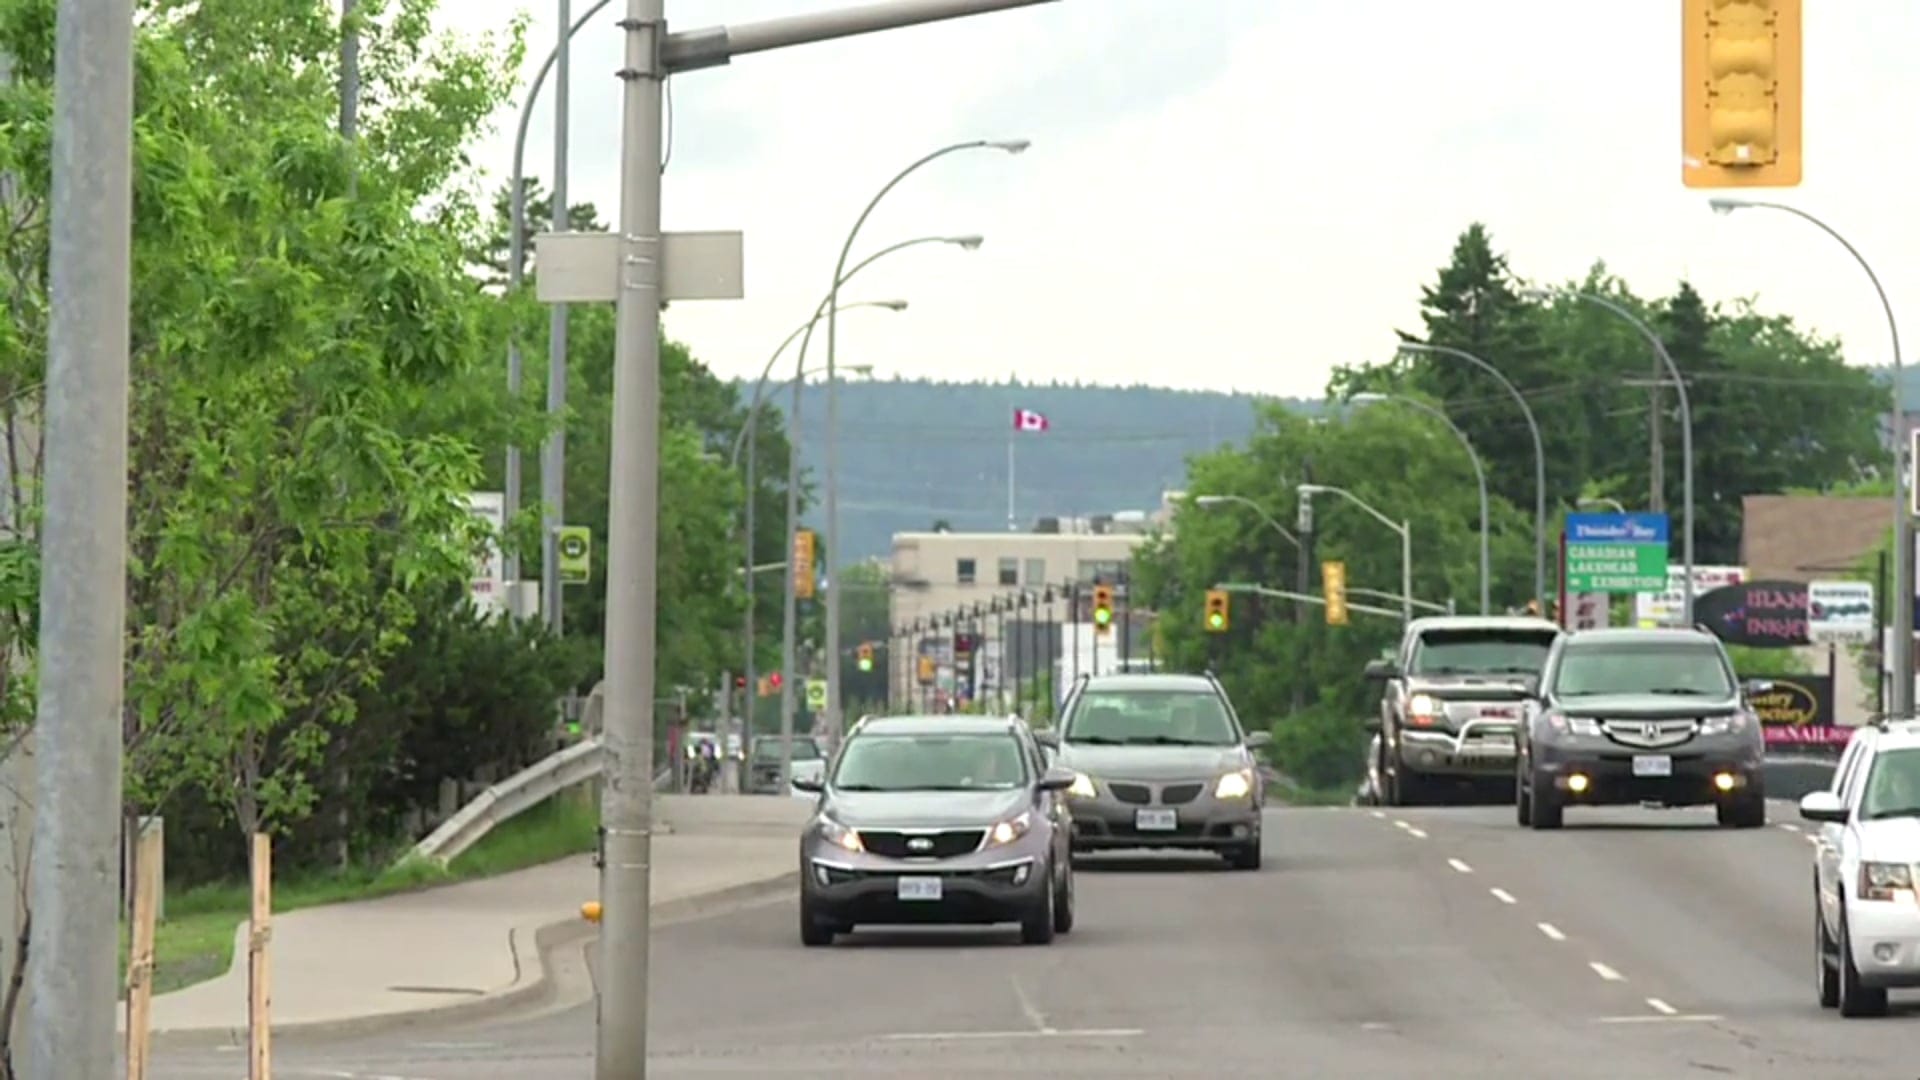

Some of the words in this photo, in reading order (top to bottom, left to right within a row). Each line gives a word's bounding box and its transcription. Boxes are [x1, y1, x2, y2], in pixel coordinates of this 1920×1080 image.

[1568, 546, 1636, 559] CANADIAN
[1568, 561, 1638, 574] LAKEHEAD
[1591, 576, 1664, 588] EXHIBITION
